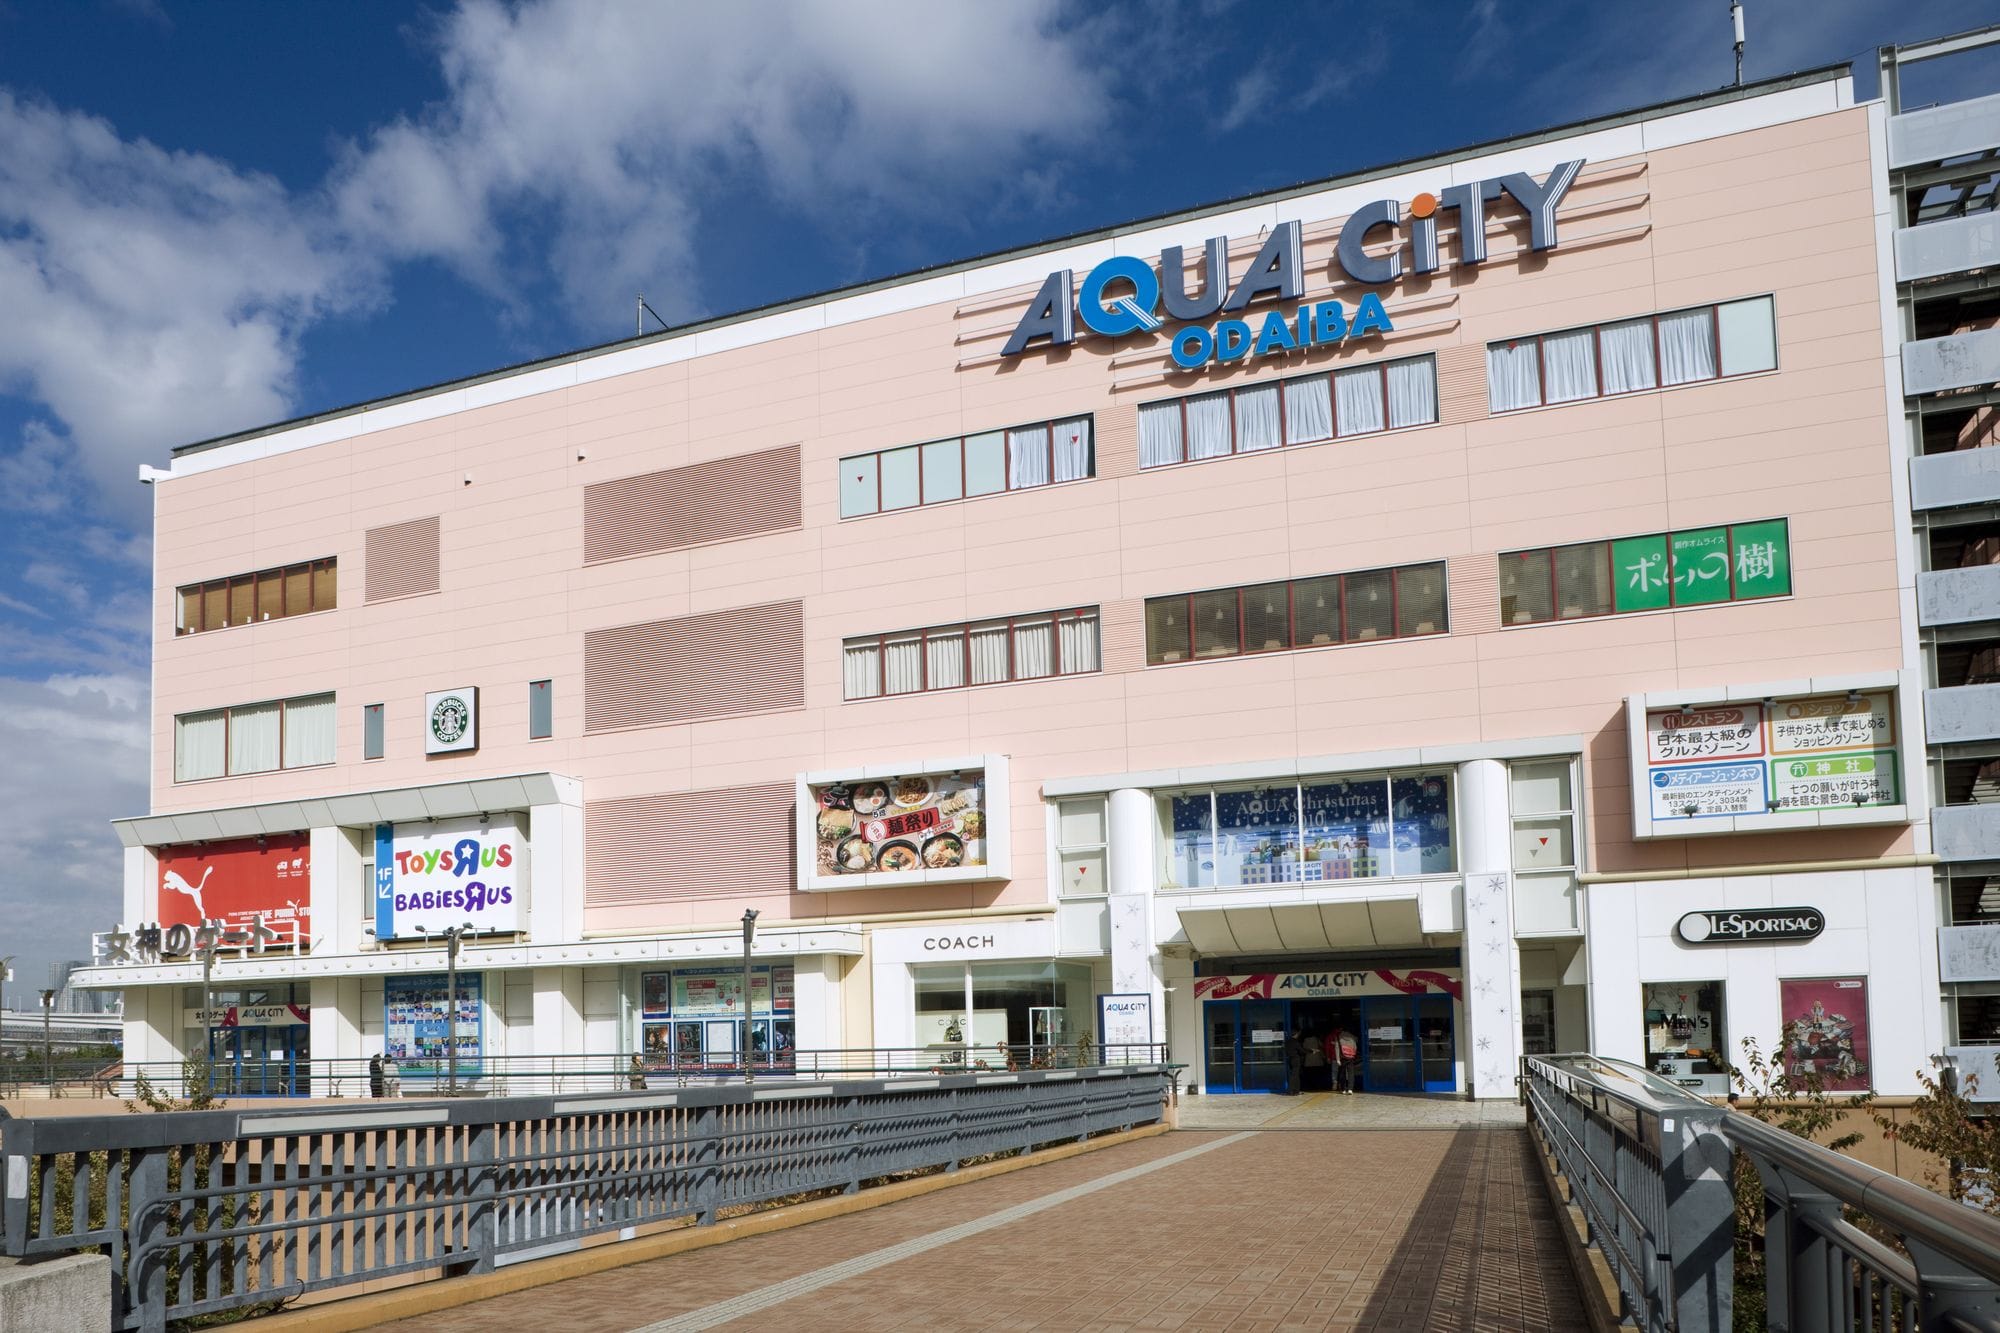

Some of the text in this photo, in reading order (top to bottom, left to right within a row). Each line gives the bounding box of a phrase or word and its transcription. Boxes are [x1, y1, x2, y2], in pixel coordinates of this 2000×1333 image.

[1001, 219, 1305, 357] AQUA
[1170, 293, 1394, 369] ODAIBA
[432, 699, 467, 721] STARBUCKS
[1681, 711, 1739, 727] レストラン
[436, 729, 463, 742] COFFEE
[1777, 717, 1886, 738] 子供から大人まで楽しめる
[1657, 728, 1752, 746] 日本最大級の
[1793, 732, 1870, 748] ショッピングゾーン
[1660, 742, 1750, 758] グルメゾーン
[1815, 759, 1861, 775] 神社
[377, 867, 393, 881] 1F
[103, 914, 279, 961] 女神のゲート
[924, 935, 994, 950] COACH
[1280, 974, 1328, 989] AQUA
[1307, 987, 1341, 997] ODAIBA
[242, 1008, 267, 1018] AQUA
[1106, 1003, 1129, 1011] AQUA
